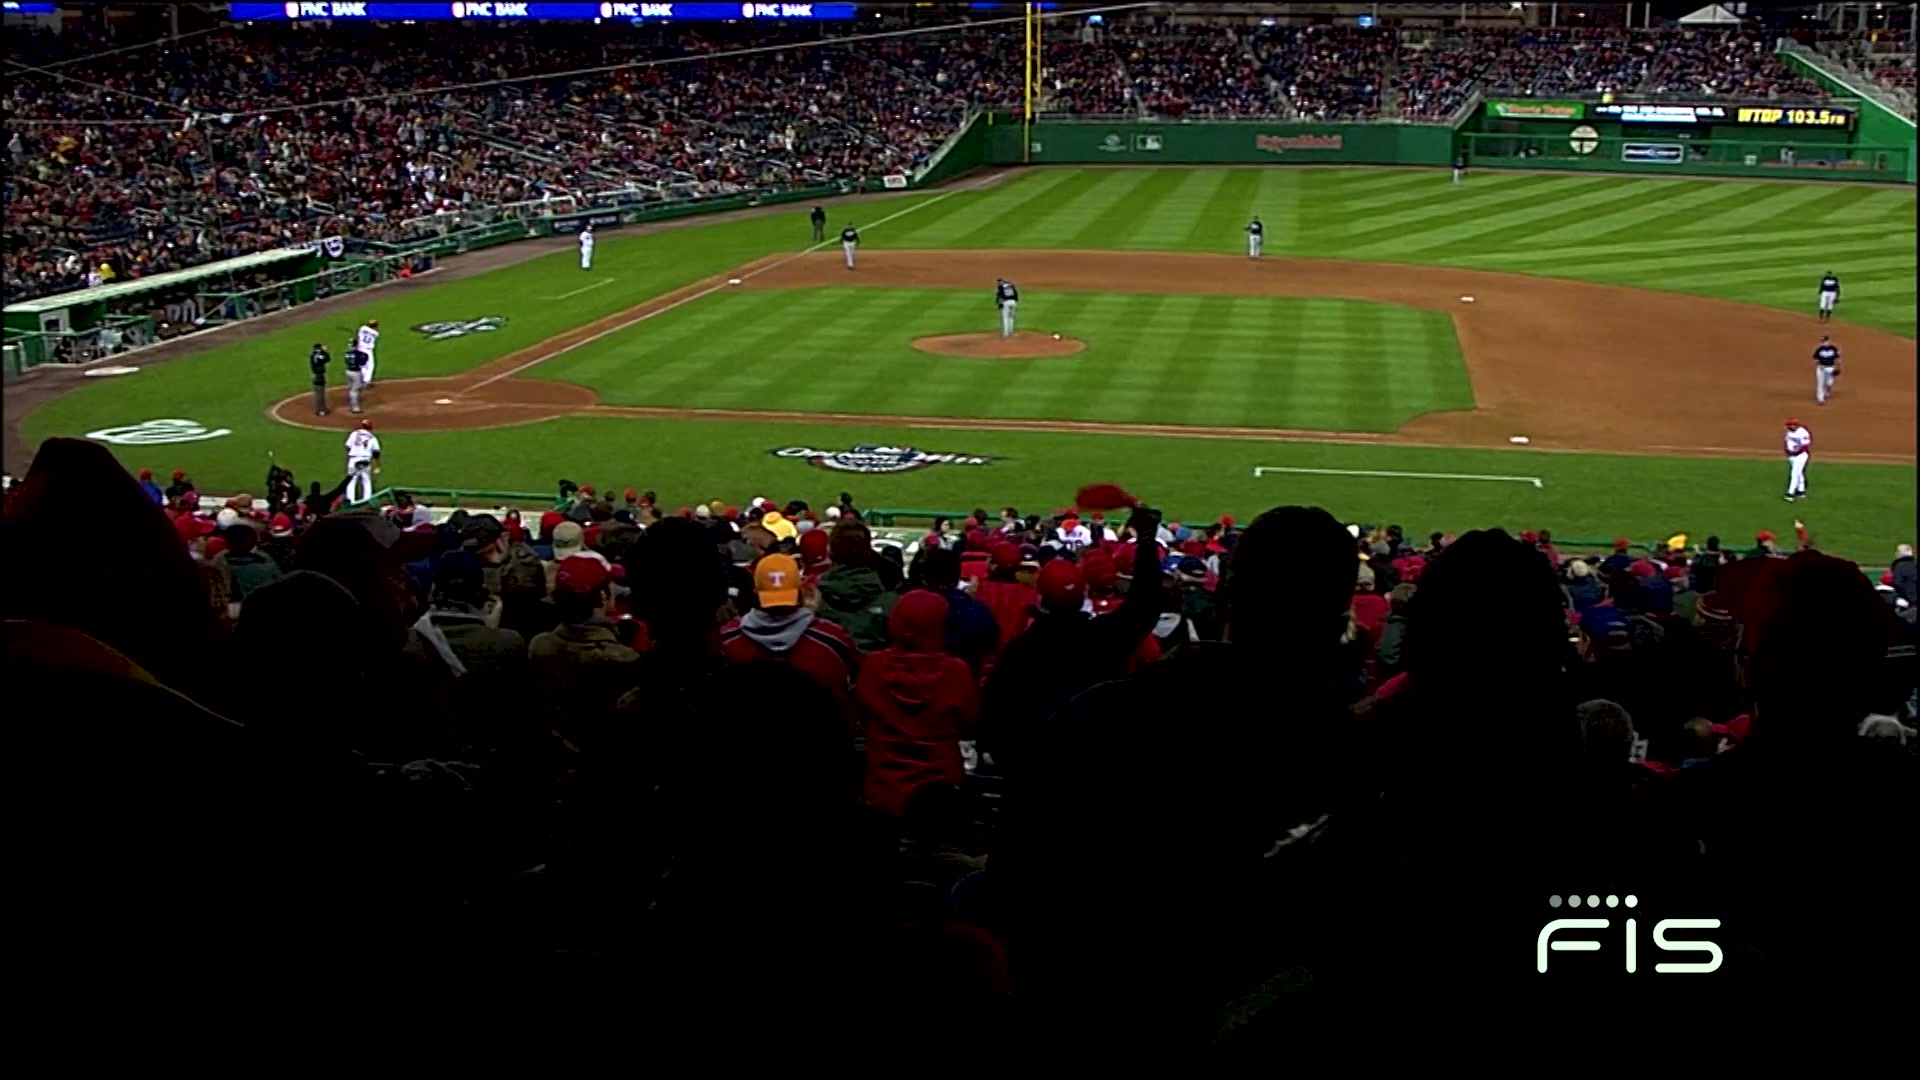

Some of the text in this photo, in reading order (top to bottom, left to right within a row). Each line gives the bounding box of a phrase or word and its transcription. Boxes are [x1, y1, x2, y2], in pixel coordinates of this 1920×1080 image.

[301, 2, 366, 16] PNC BANK
[466, 2, 528, 16] PNC BANK
[1738, 109, 1783, 123] WTOP
[768, 571, 785, 588] T
